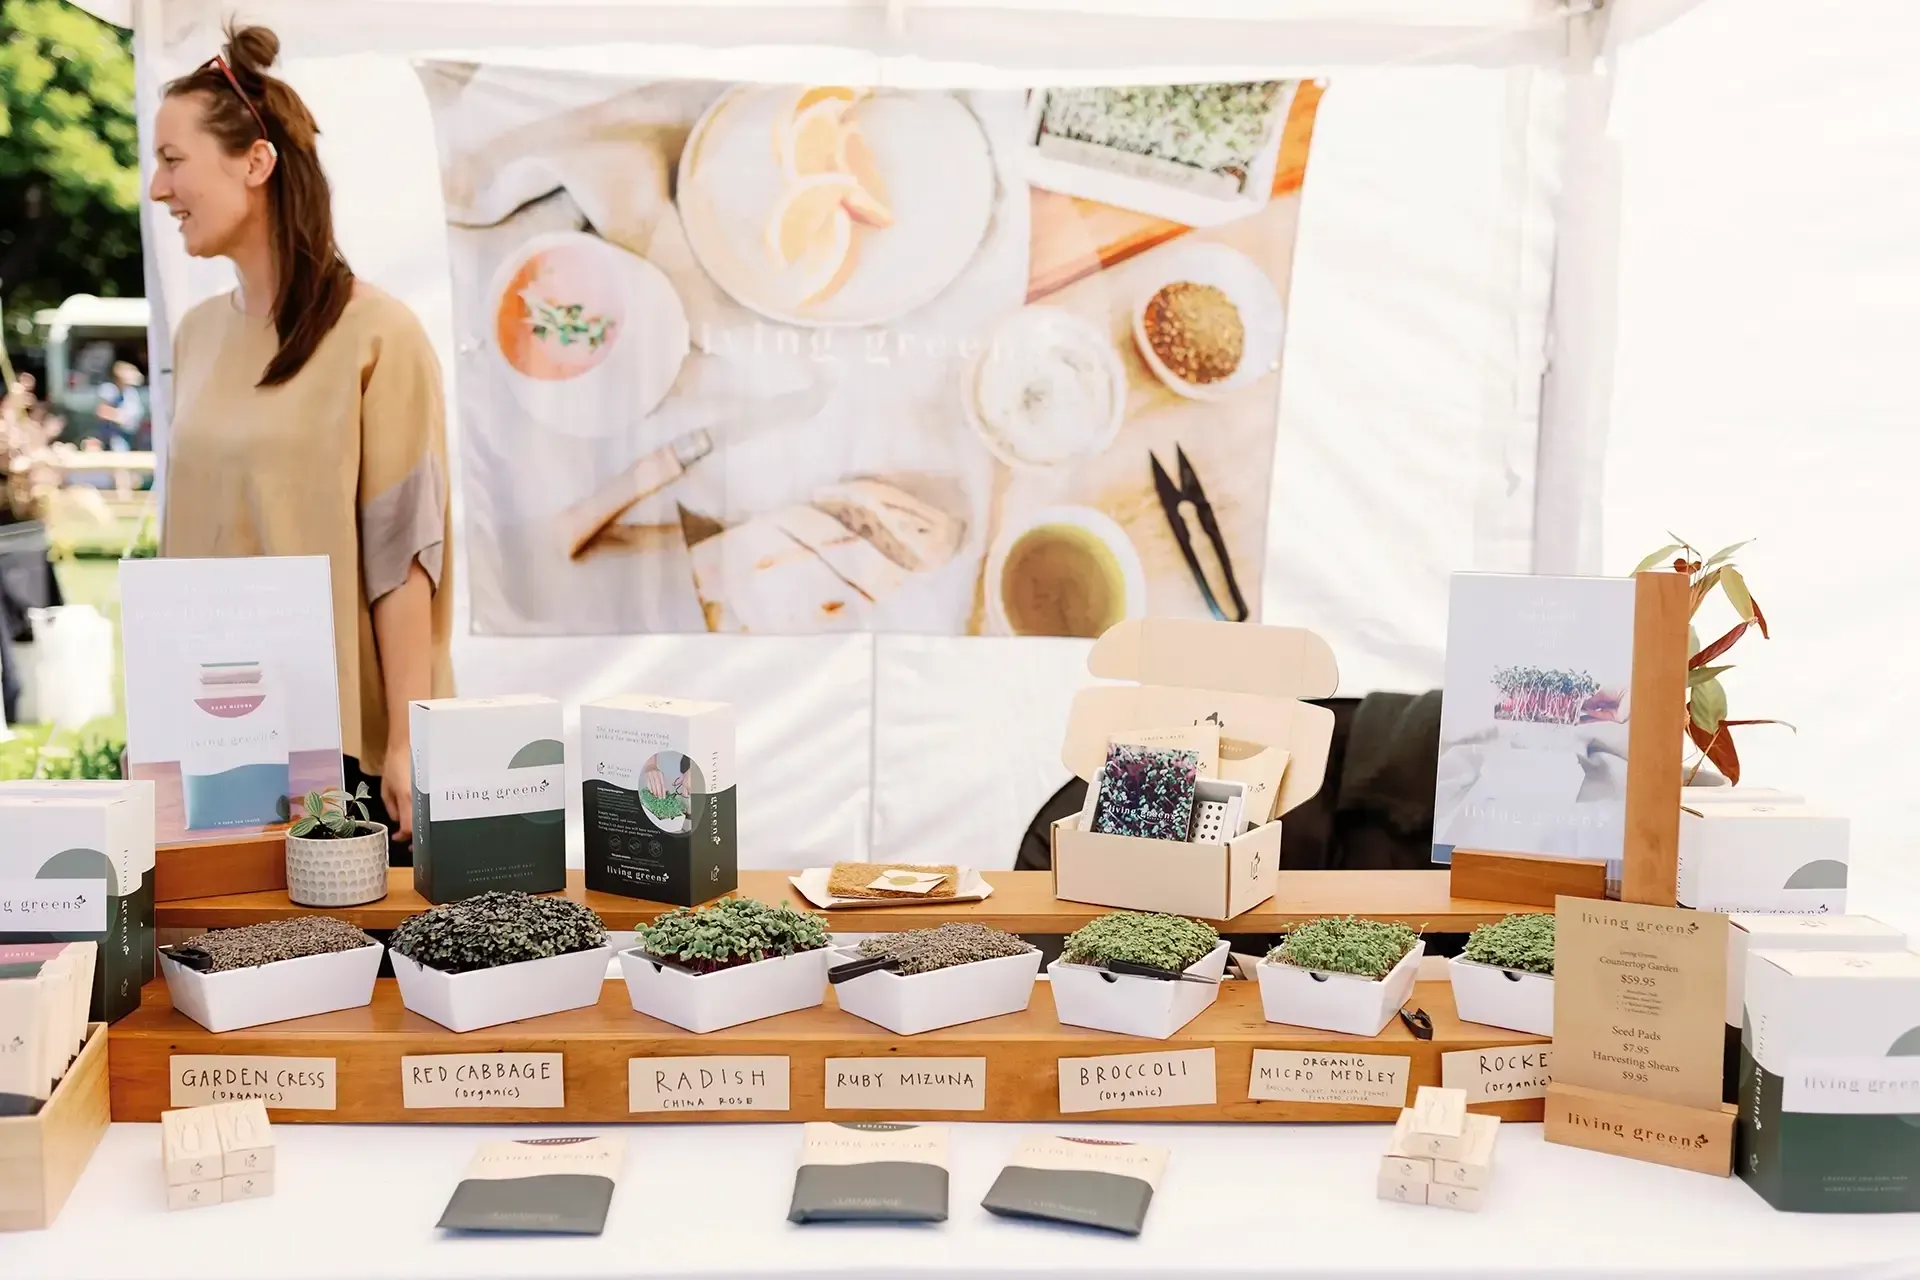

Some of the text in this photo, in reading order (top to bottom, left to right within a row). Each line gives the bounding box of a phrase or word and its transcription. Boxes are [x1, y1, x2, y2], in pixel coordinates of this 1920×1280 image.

[700, 322, 838, 364] iving
[444, 784, 547, 802] living greens
[1107, 804, 1137, 816] living
[606, 865, 633, 879] living
[635, 871, 667, 883] greens
[20, 900, 81, 914] greens
[1582, 912, 1695, 936] living greens
[1599, 955, 1679, 973] Countertop Garden
[1620, 974, 1656, 988] $59.95
[1611, 1025, 1662, 1042] Seed Pads
[1622, 1043, 1650, 1055] $7.95
[1302, 1057, 1365, 1068] ORGANIC
[1479, 1052, 1552, 1075] ROCKE
[1592, 1050, 1680, 1073] Harvesting Shears
[181, 1068, 325, 1089] GARDEN CRESS
[412, 1062, 551, 1085] RED CABBAGE
[655, 1068, 766, 1094] RADISH
[836, 1072, 975, 1089] RUBY MIZUNA
[1079, 1060, 1188, 1086] BROCCOLI
[1259, 1067, 1396, 1085] MICRO MEDLEY
[1622, 1070, 1649, 1083] $9.95
[454, 1085, 520, 1099] (organic)
[1485, 1075, 1552, 1094] (organic)
[1804, 1076, 1919, 1093] living green
[211, 1091, 284, 1102] (ORGANIC)
[663, 1096, 753, 1109] CHINA ROSE
[1099, 1086, 1163, 1102] (organic)
[1567, 1112, 1703, 1149] living greens
